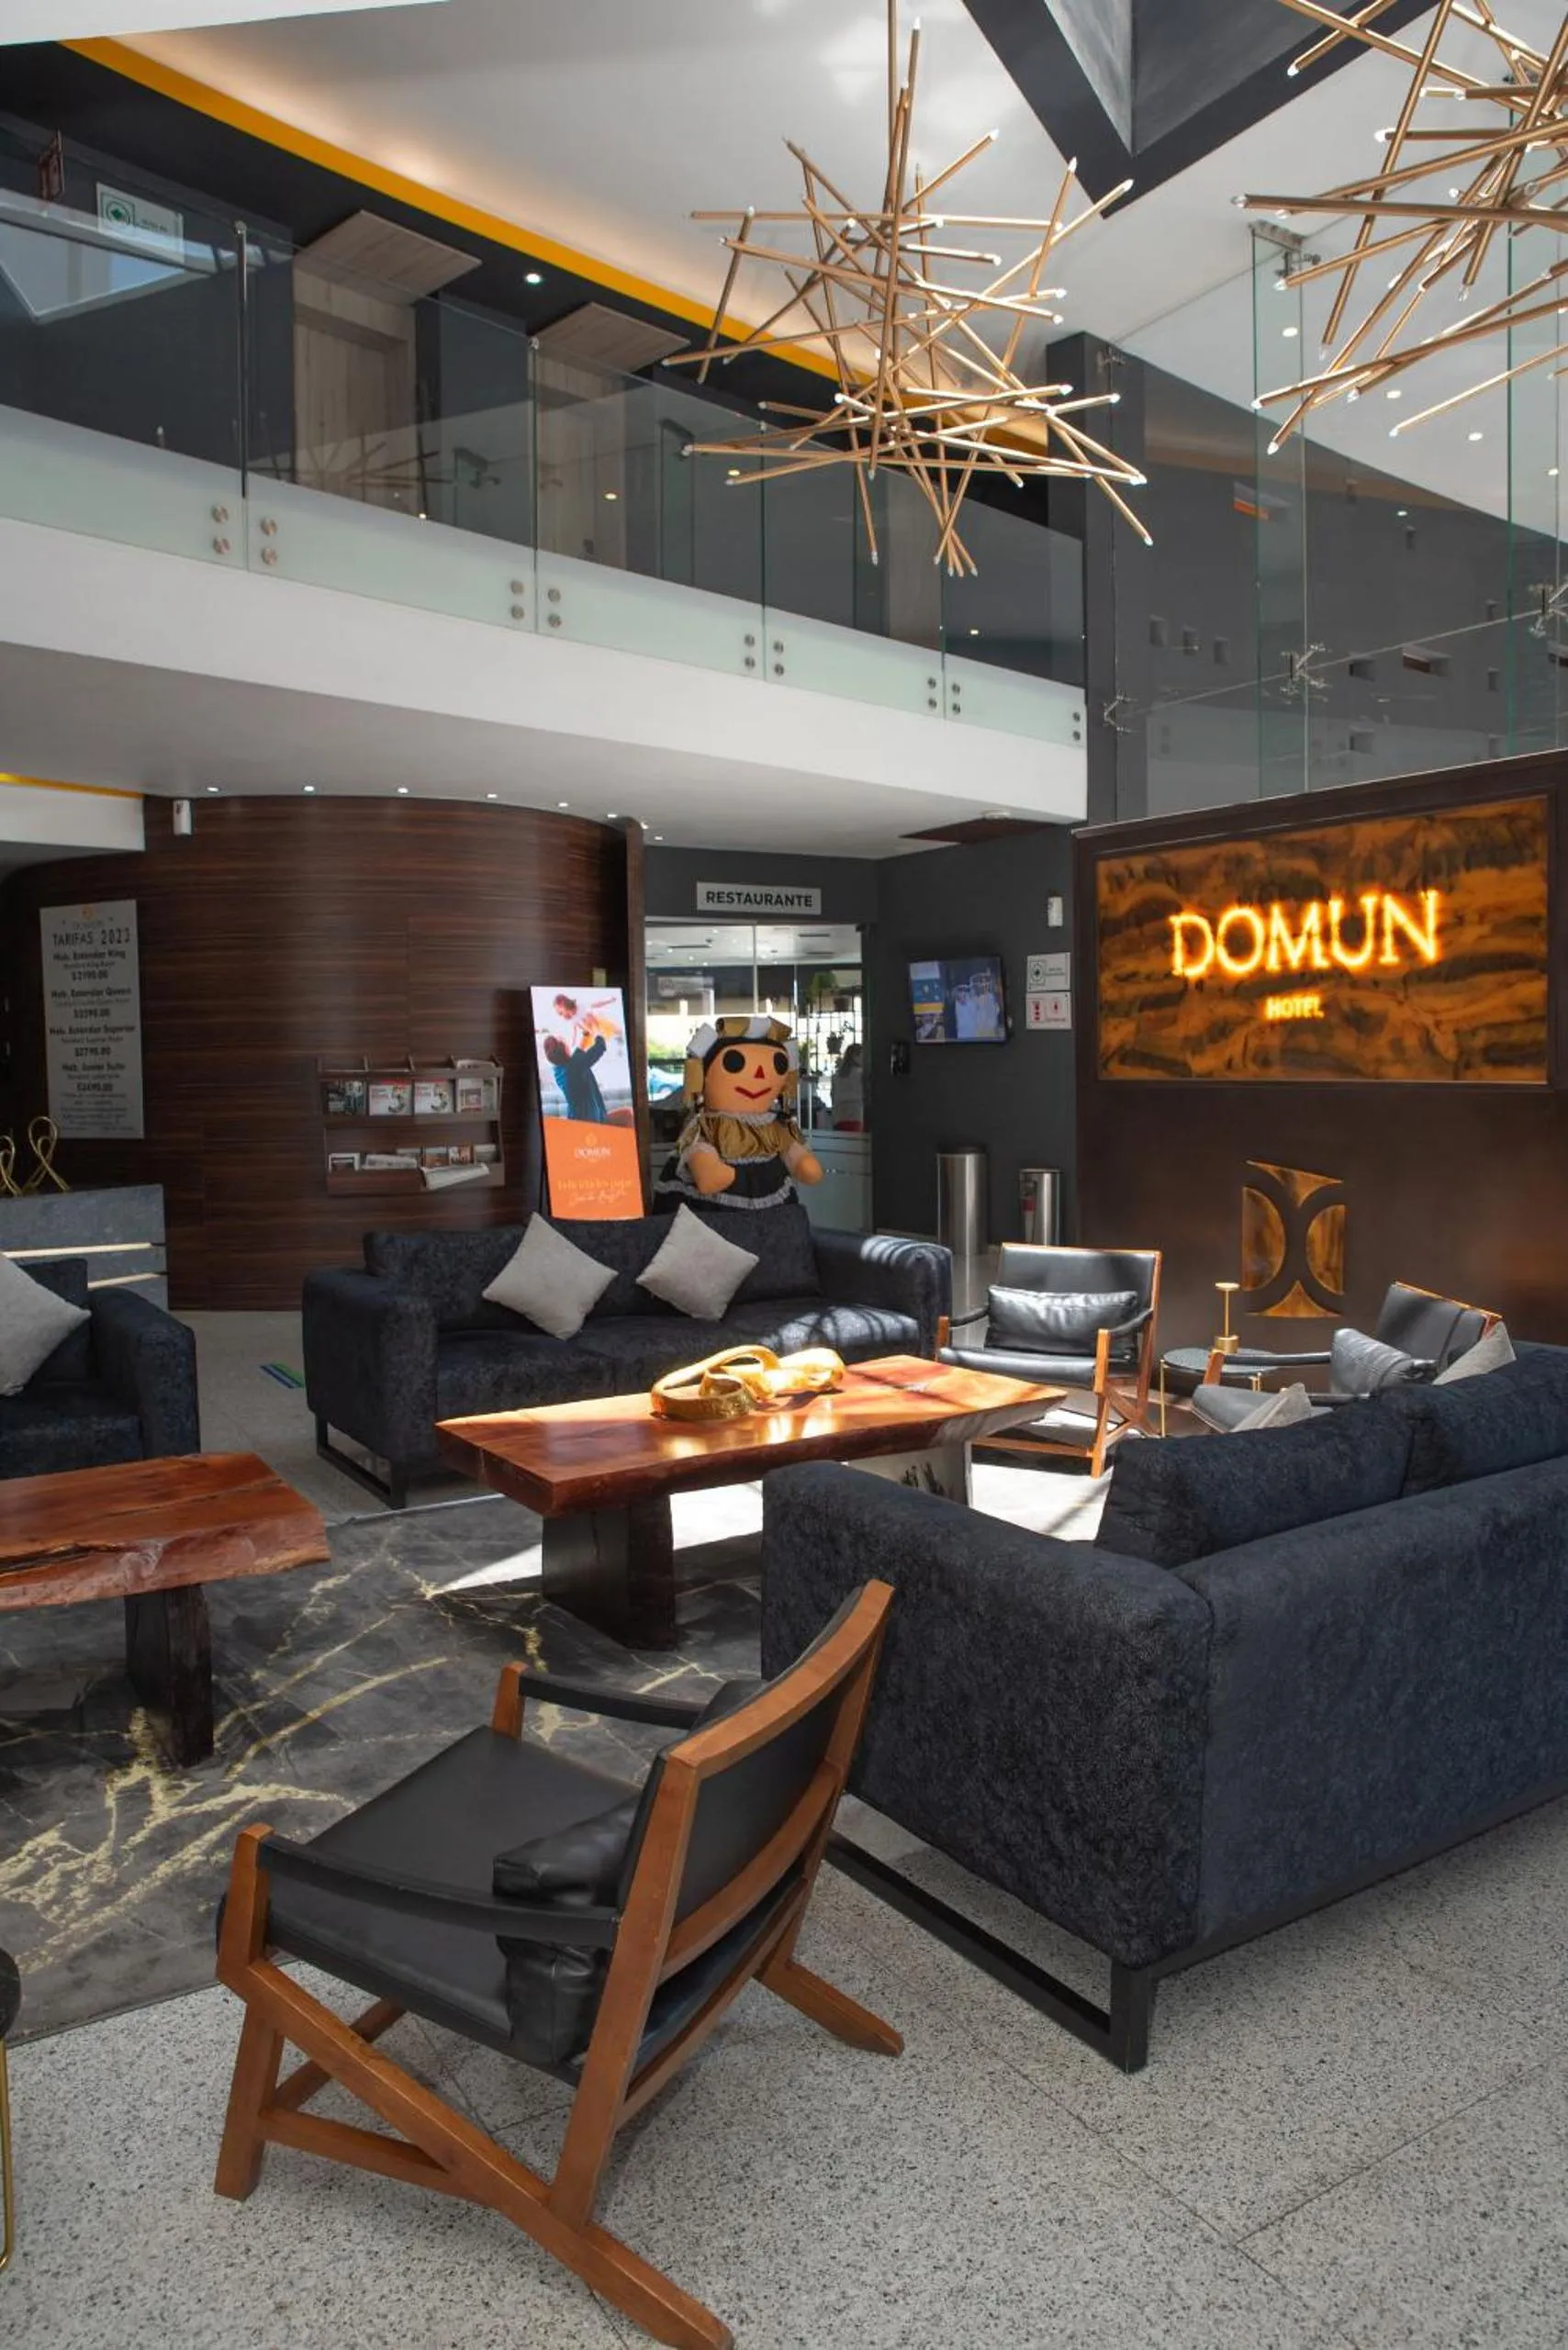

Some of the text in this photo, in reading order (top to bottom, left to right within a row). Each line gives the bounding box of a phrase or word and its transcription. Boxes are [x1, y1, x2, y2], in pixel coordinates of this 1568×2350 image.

[705, 890, 813, 908] RESTAURANTE
[52, 927, 130, 947] TARIFAS 2023
[1169, 889, 1439, 977] DOMUN
[1264, 995, 1325, 1020] HOTEL
